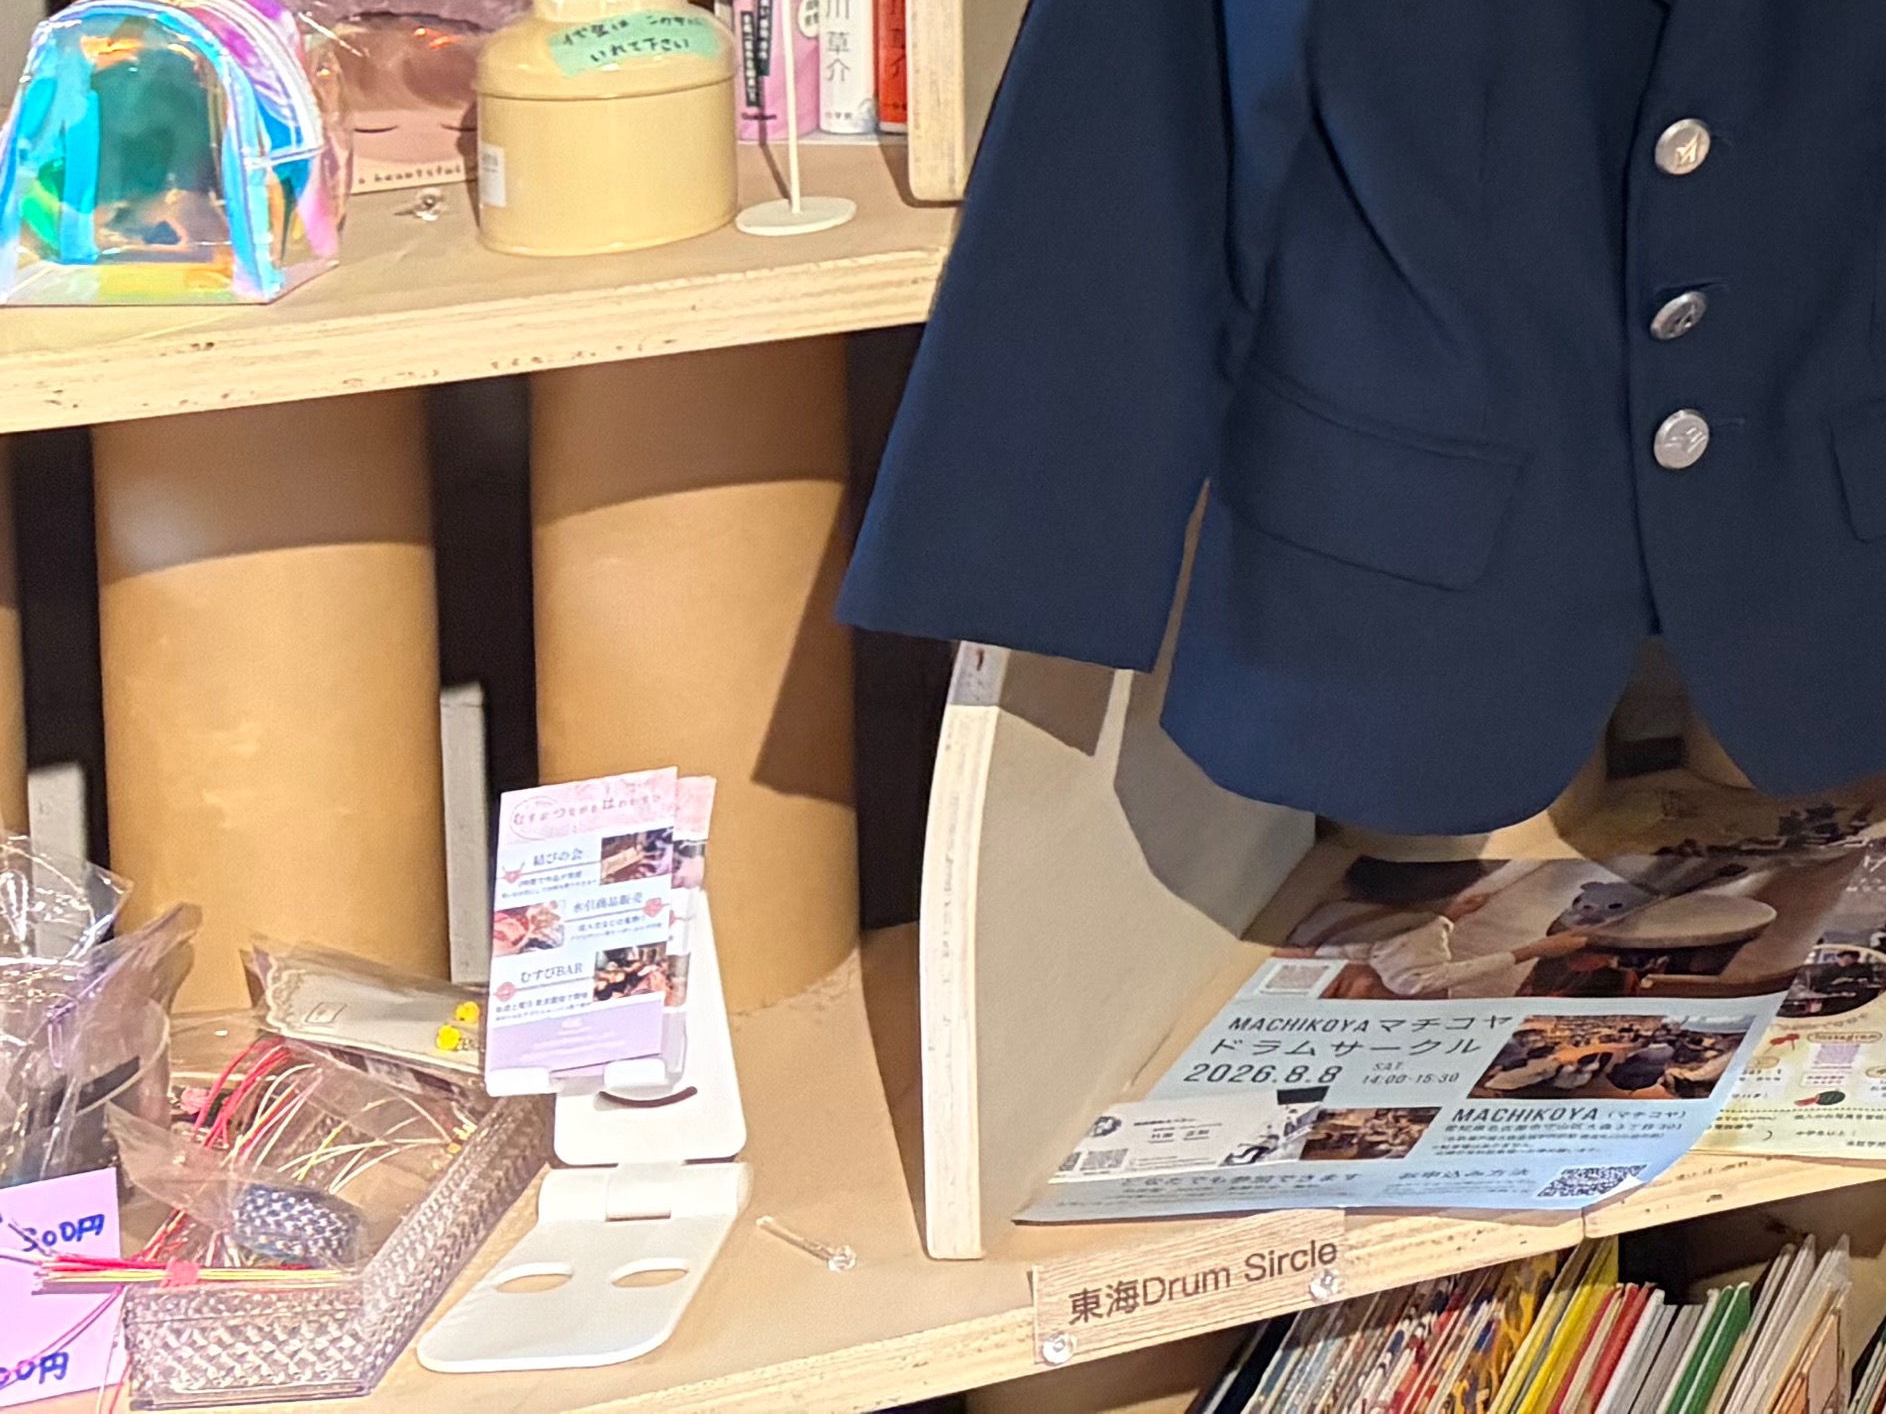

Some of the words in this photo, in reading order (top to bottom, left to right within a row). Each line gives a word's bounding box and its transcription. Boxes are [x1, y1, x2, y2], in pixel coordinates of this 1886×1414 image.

[520, 962, 584, 984] むすびBAR
[1228, 1016, 1370, 1035] MACHIKOYA
[1378, 1014, 1515, 1034] マチコヤ
[1209, 1037, 1483, 1058] ドラムサークル
[1182, 1064, 1345, 1085] 2026.8.8
[1452, 1107, 1601, 1123] MACHIKOYA
[1067, 1269, 1235, 1329] 東海Drum
[1244, 1237, 1341, 1284] Sircle
